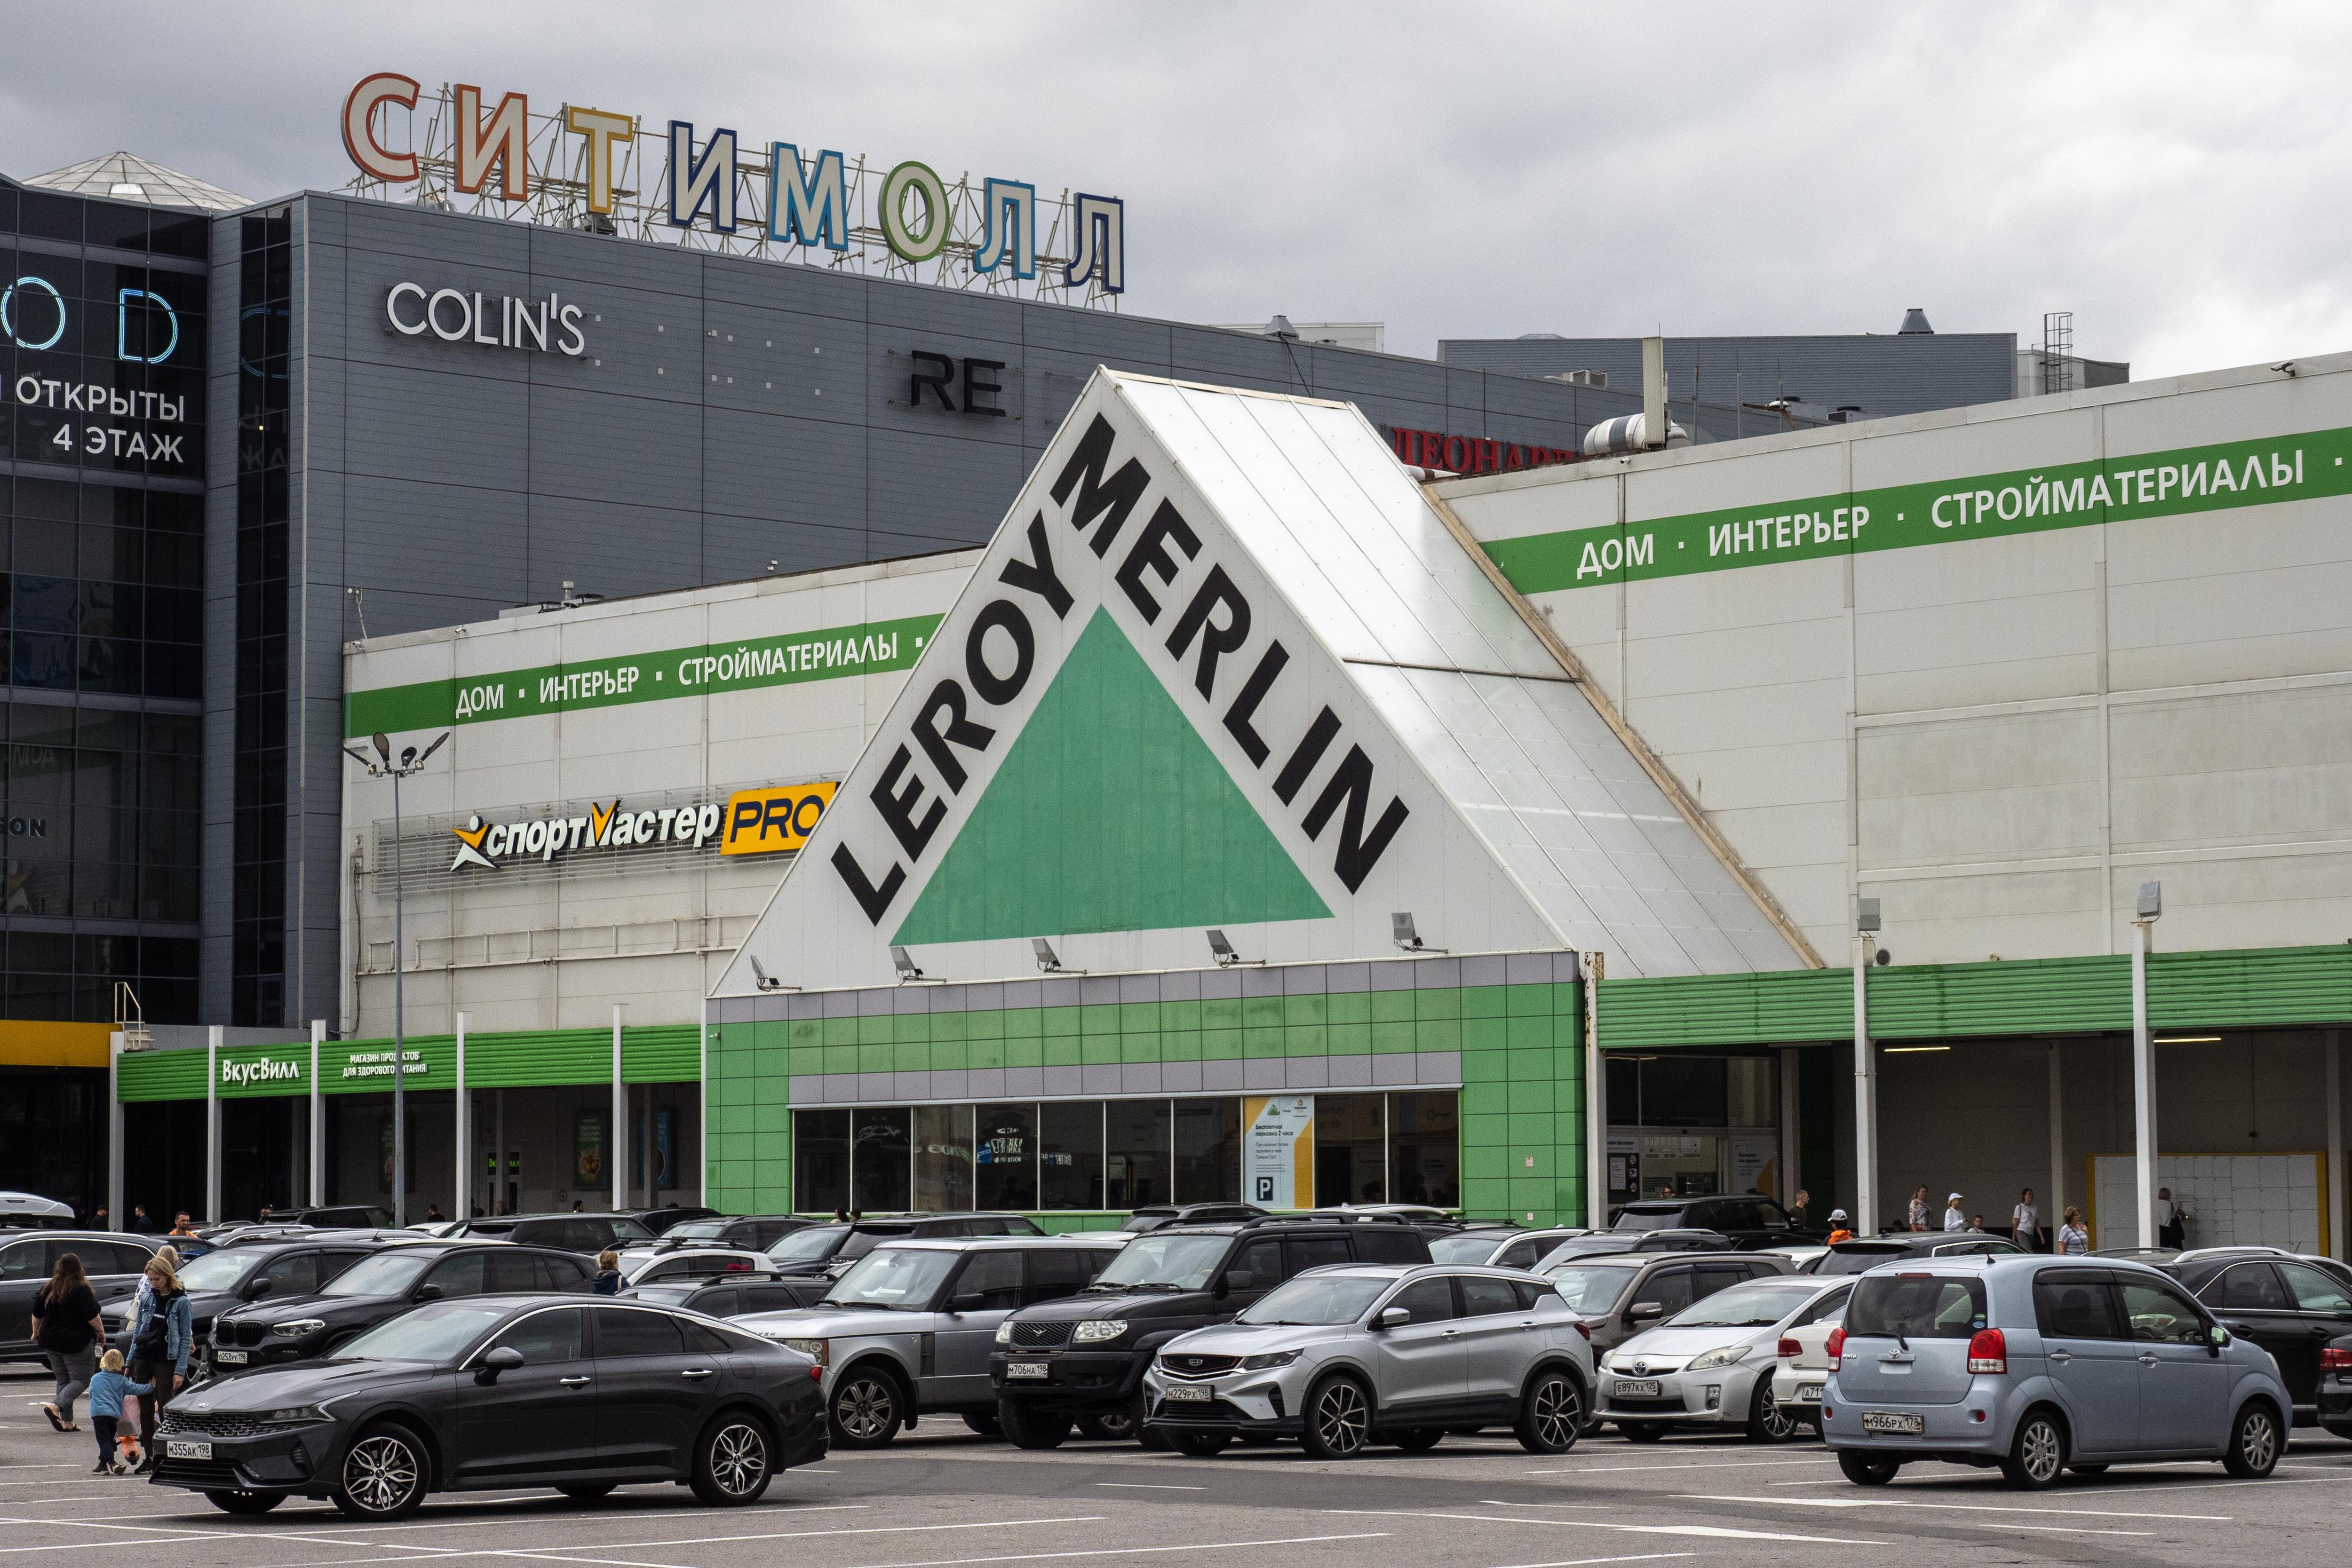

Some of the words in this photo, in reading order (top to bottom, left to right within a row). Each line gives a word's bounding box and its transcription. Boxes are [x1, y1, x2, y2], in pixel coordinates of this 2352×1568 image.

[341, 72, 1124, 294] СИТИМОЛЛ
[387, 282, 585, 356] COLIN'S
[16, 376, 184, 422] ОТКРЫТЫ
[911, 349, 1006, 417] RE
[53, 424, 73, 451] 4
[85, 427, 183, 463] ЭТАЖ
[1576, 534, 1654, 579] ДОМ
[1709, 506, 1870, 557] ИНТЕРЬЕР
[1931, 450, 2303, 529] СТРОЙМАТЕРИАЛЫ
[455, 684, 504, 719] ДОМ
[540, 666, 639, 703] ИНТЕРЬЕР
[678, 632, 897, 685] СТРОЙМАТЕРИАЛЫ
[1050, 412, 1410, 895] MERLIN
[830, 509, 1074, 927] LEROY
[730, 795, 825, 843] PRO
[222, 1057, 300, 1086] ВкусВилл
[342, 1068, 356, 1078] ДЛЯ
[358, 1065, 395, 1077] ЗДОРОВОГО
[350, 1053, 379, 1063] МАГАЗИН
[198, 1444, 209, 1454] 198
